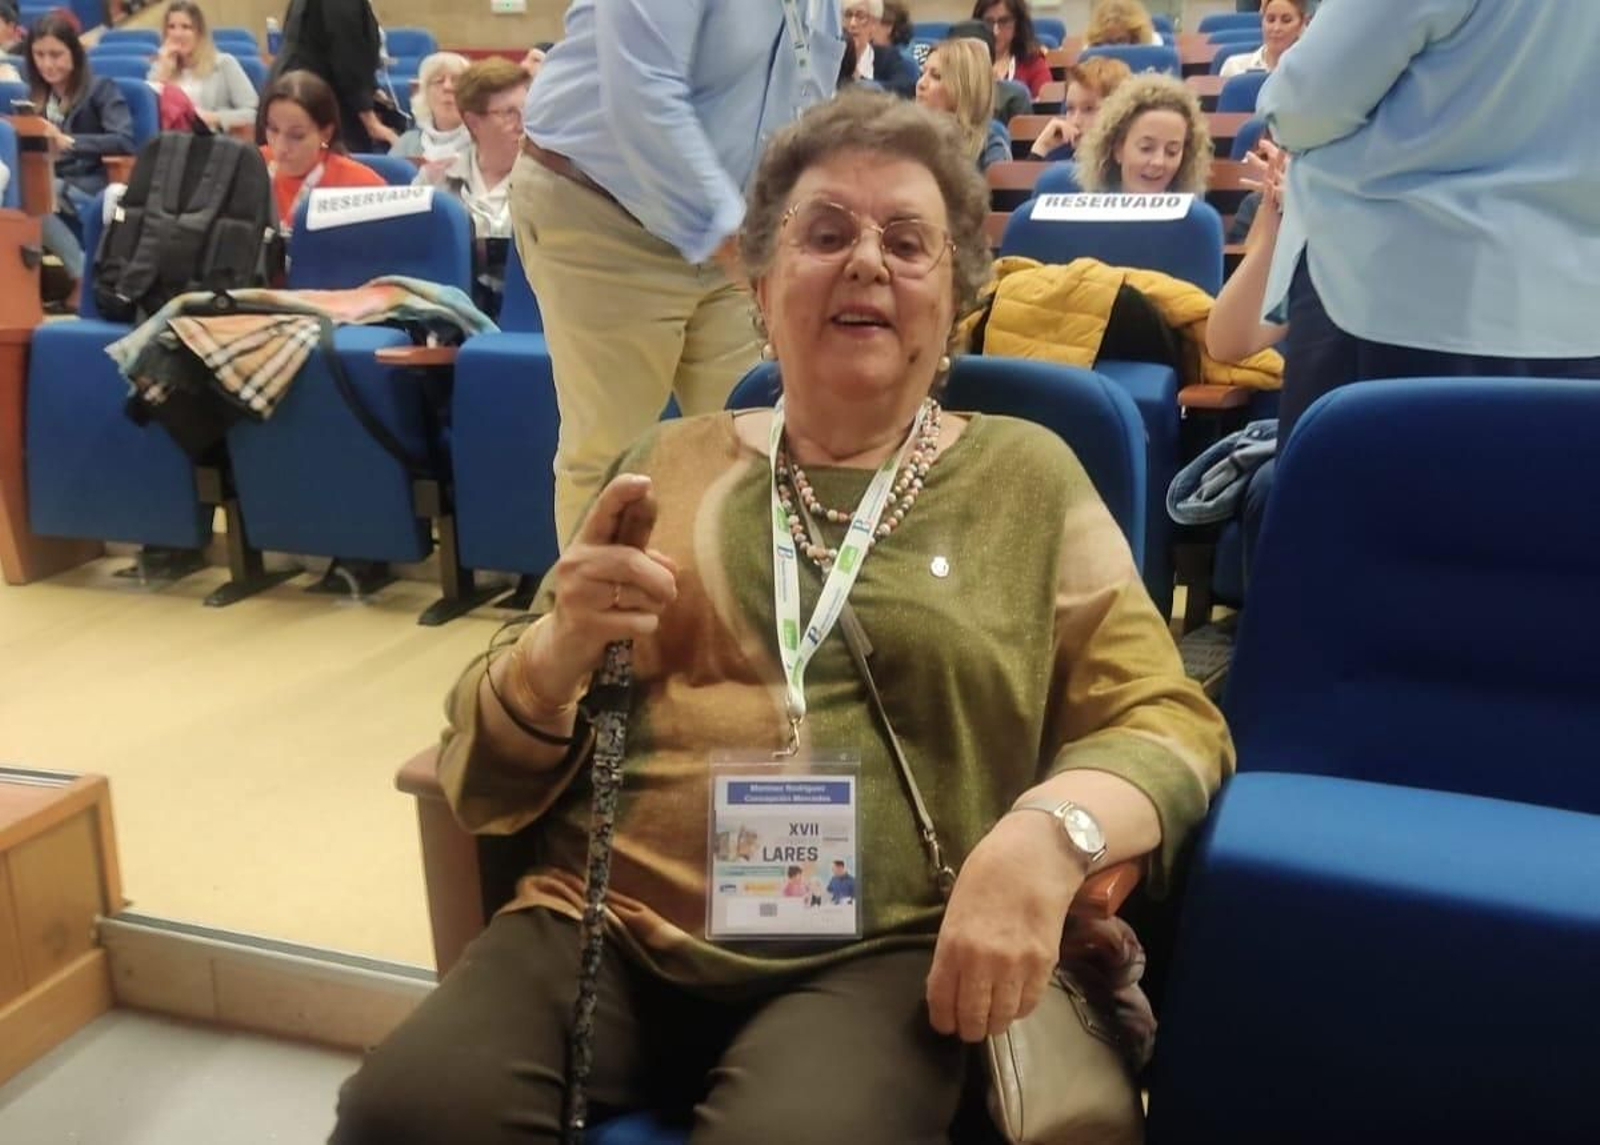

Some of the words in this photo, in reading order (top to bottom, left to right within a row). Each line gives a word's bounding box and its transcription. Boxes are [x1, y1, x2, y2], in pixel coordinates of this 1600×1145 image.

[317, 188, 424, 213] RESERVADO
[1045, 195, 1182, 209] RESERVADO
[789, 822, 819, 836] XVII
[762, 846, 819, 862] LARES
